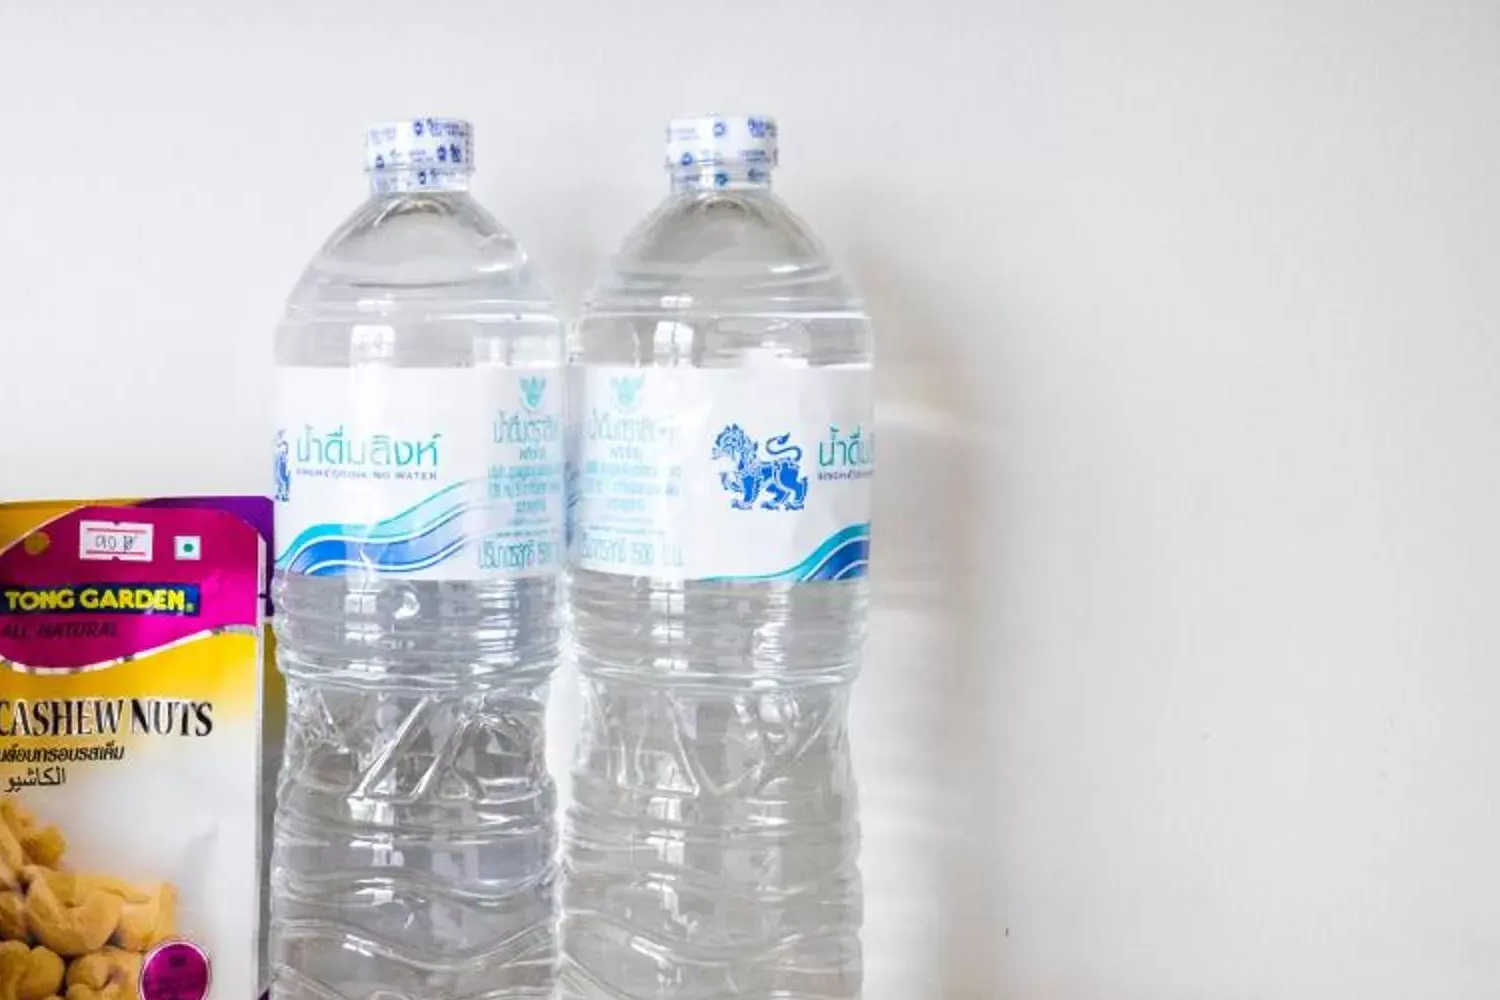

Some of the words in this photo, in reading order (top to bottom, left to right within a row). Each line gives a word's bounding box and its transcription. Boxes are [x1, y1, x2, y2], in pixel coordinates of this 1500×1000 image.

[4, 589, 75, 609] TONG
[79, 588, 186, 611] GARDEN
[35, 621, 119, 639] NATURAL
[131, 700, 214, 737] NUTS
